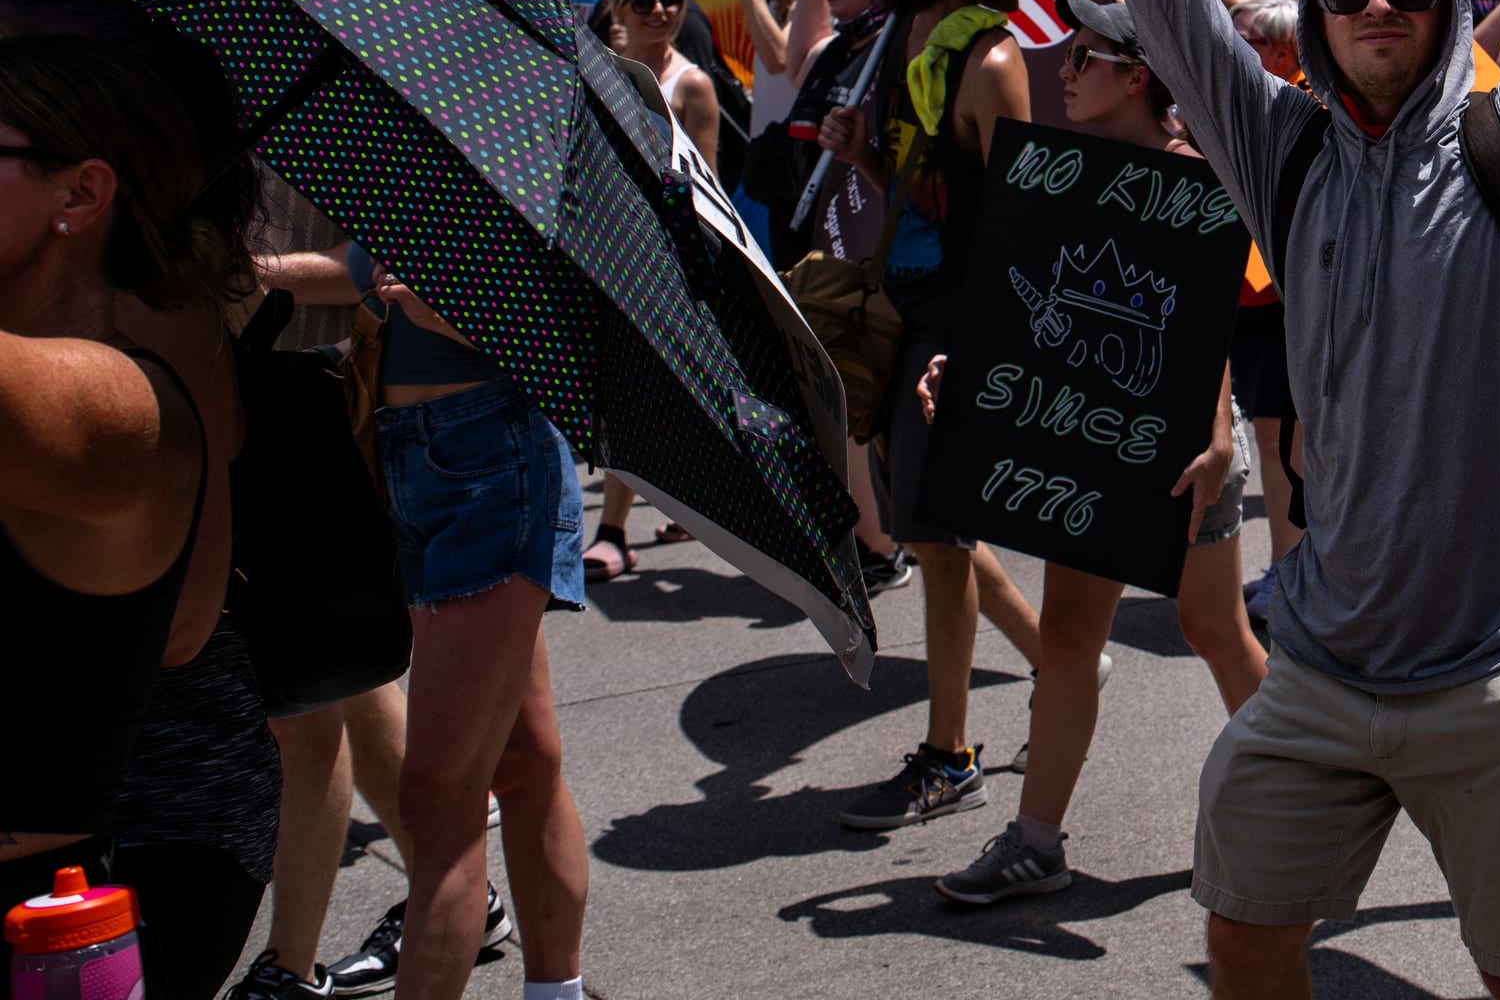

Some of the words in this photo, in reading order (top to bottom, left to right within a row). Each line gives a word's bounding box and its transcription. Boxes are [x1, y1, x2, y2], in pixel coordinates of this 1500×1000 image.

[1006, 141, 1084, 195] NO
[1097, 161, 1239, 234] KING
[977, 364, 1167, 463] SINCE
[982, 459, 1101, 536] 1776
